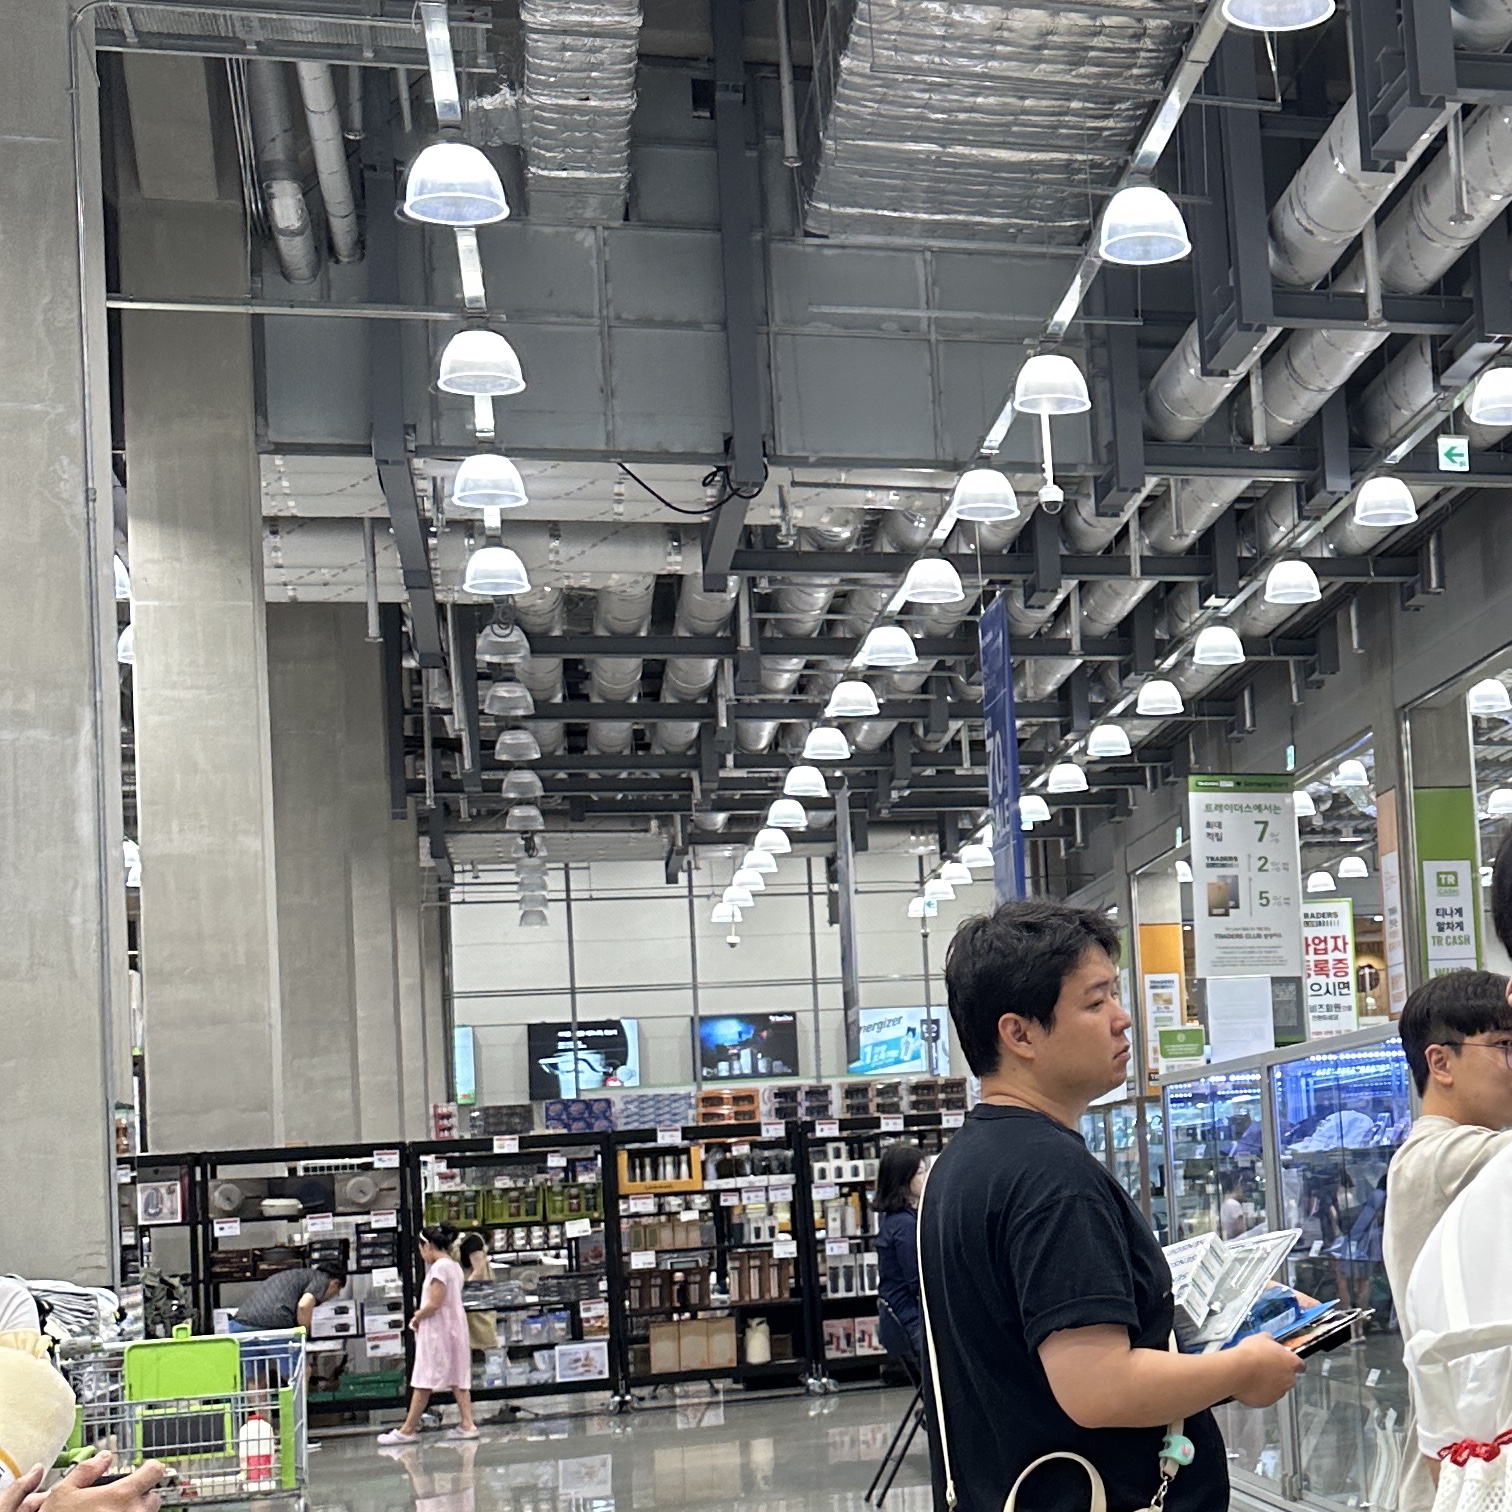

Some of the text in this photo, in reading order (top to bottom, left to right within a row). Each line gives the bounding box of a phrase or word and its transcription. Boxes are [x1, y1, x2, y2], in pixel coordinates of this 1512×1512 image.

[1439, 874, 1456, 884] TR
[1304, 911, 1338, 919] RADERS
[1435, 907, 1463, 918] 티나게
[1436, 921, 1464, 932] 알차게
[1432, 934, 1471, 946] TR CASH
[1309, 981, 1351, 997] 으시면
[861, 1016, 904, 1033] nergizer
